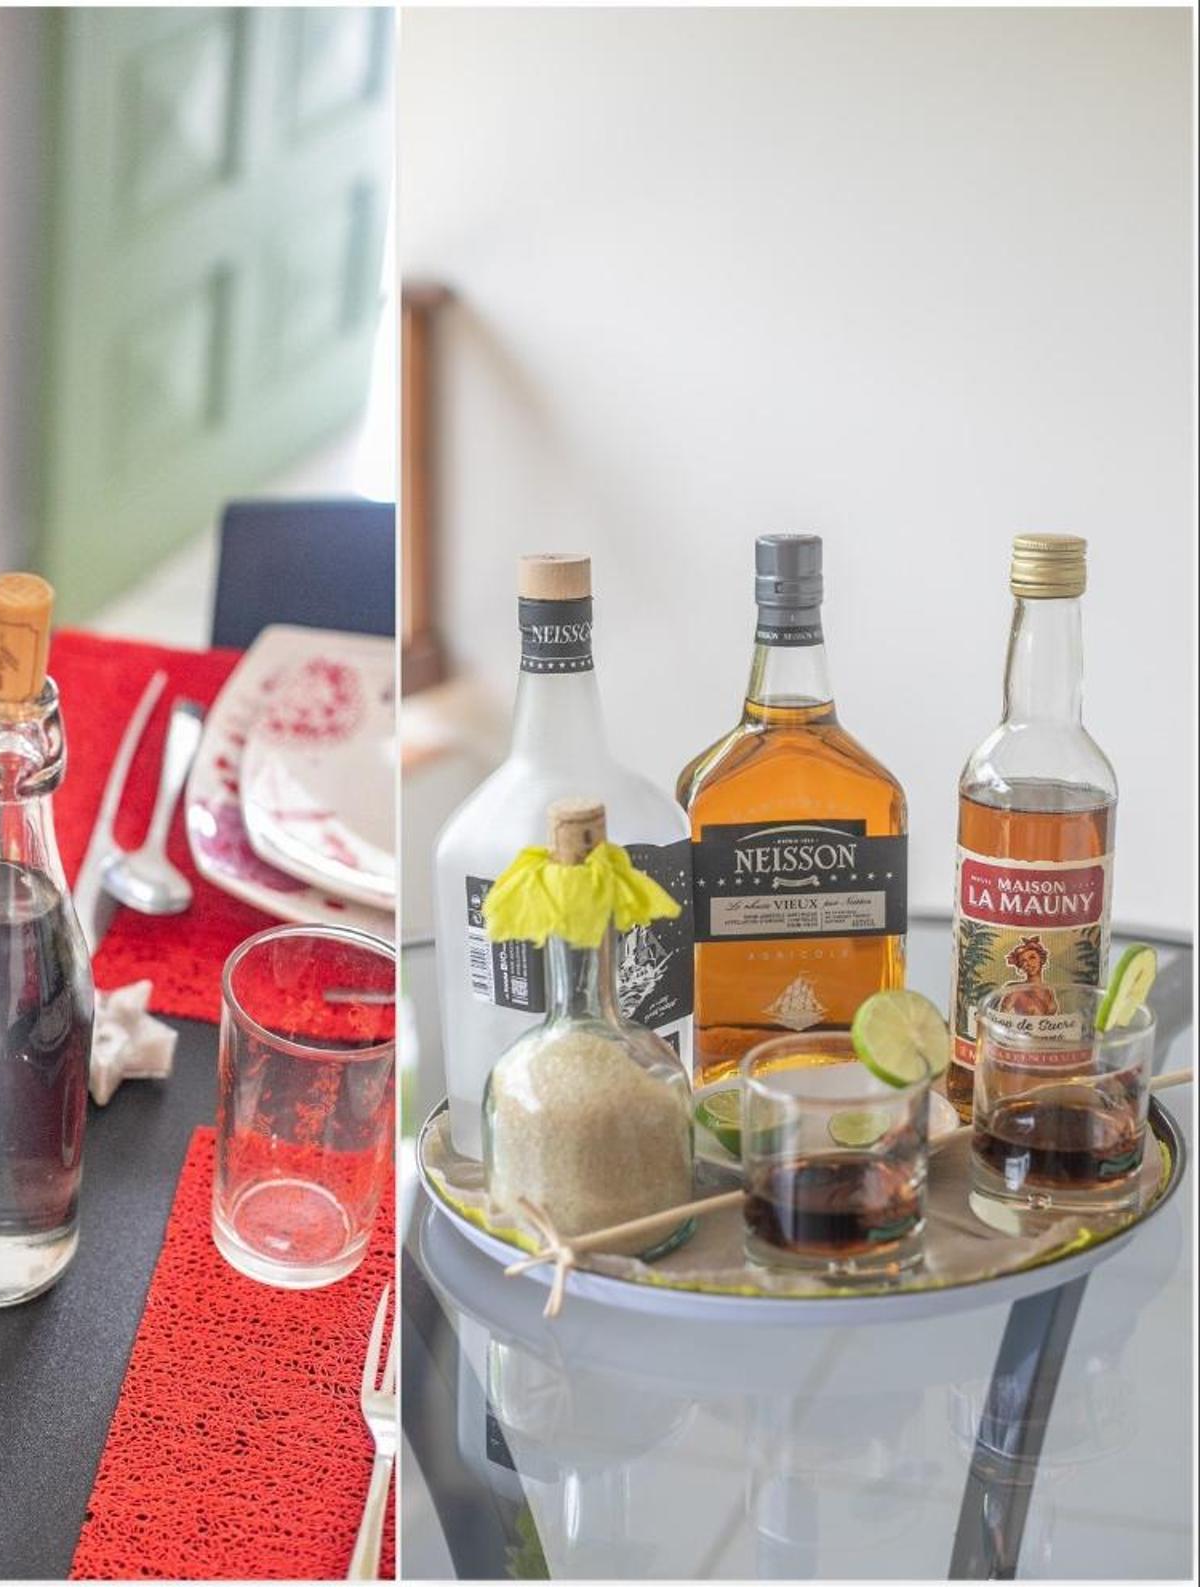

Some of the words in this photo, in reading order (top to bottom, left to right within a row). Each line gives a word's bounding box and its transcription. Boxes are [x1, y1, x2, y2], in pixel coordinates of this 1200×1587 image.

[734, 843, 857, 873] NEISSON
[998, 878, 1066, 894] MAISON
[774, 899, 818, 910] VIEUX
[968, 885, 995, 910] LA
[1000, 891, 1095, 914] MAUNY
[1017, 1018, 1033, 1030] de
